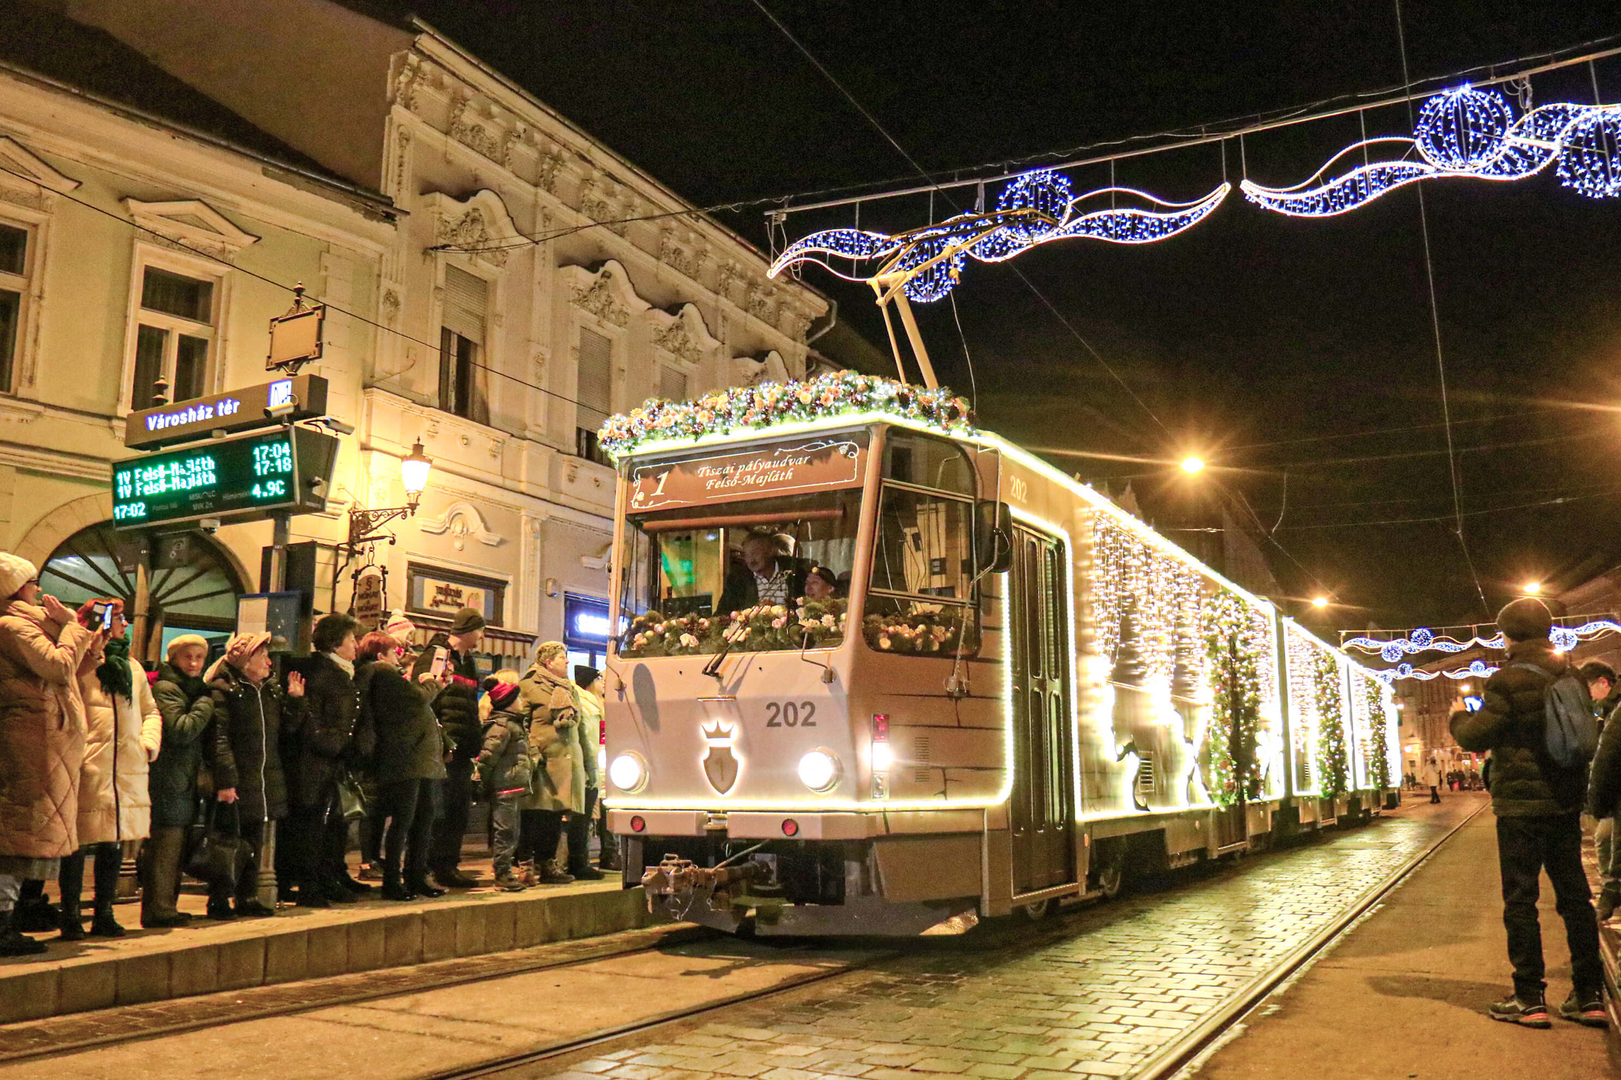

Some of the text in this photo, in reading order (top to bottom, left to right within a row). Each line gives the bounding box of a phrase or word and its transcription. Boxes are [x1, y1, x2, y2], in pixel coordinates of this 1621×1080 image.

[147, 398, 240, 431] Városház tér
[117, 471, 131, 485] 1V
[253, 442, 291, 461] 17:04
[698, 455, 811, 478] Tiszai pályaudvar
[118, 484, 132, 499] 1V
[254, 457, 292, 476] 17:18
[251, 479, 285, 498] 4.9C
[650, 471, 669, 496] 1
[706, 468, 794, 490] Felső-Majláth
[1010, 475, 1027, 504] 202
[113, 502, 147, 520] 17:02
[765, 701, 817, 728] 202
